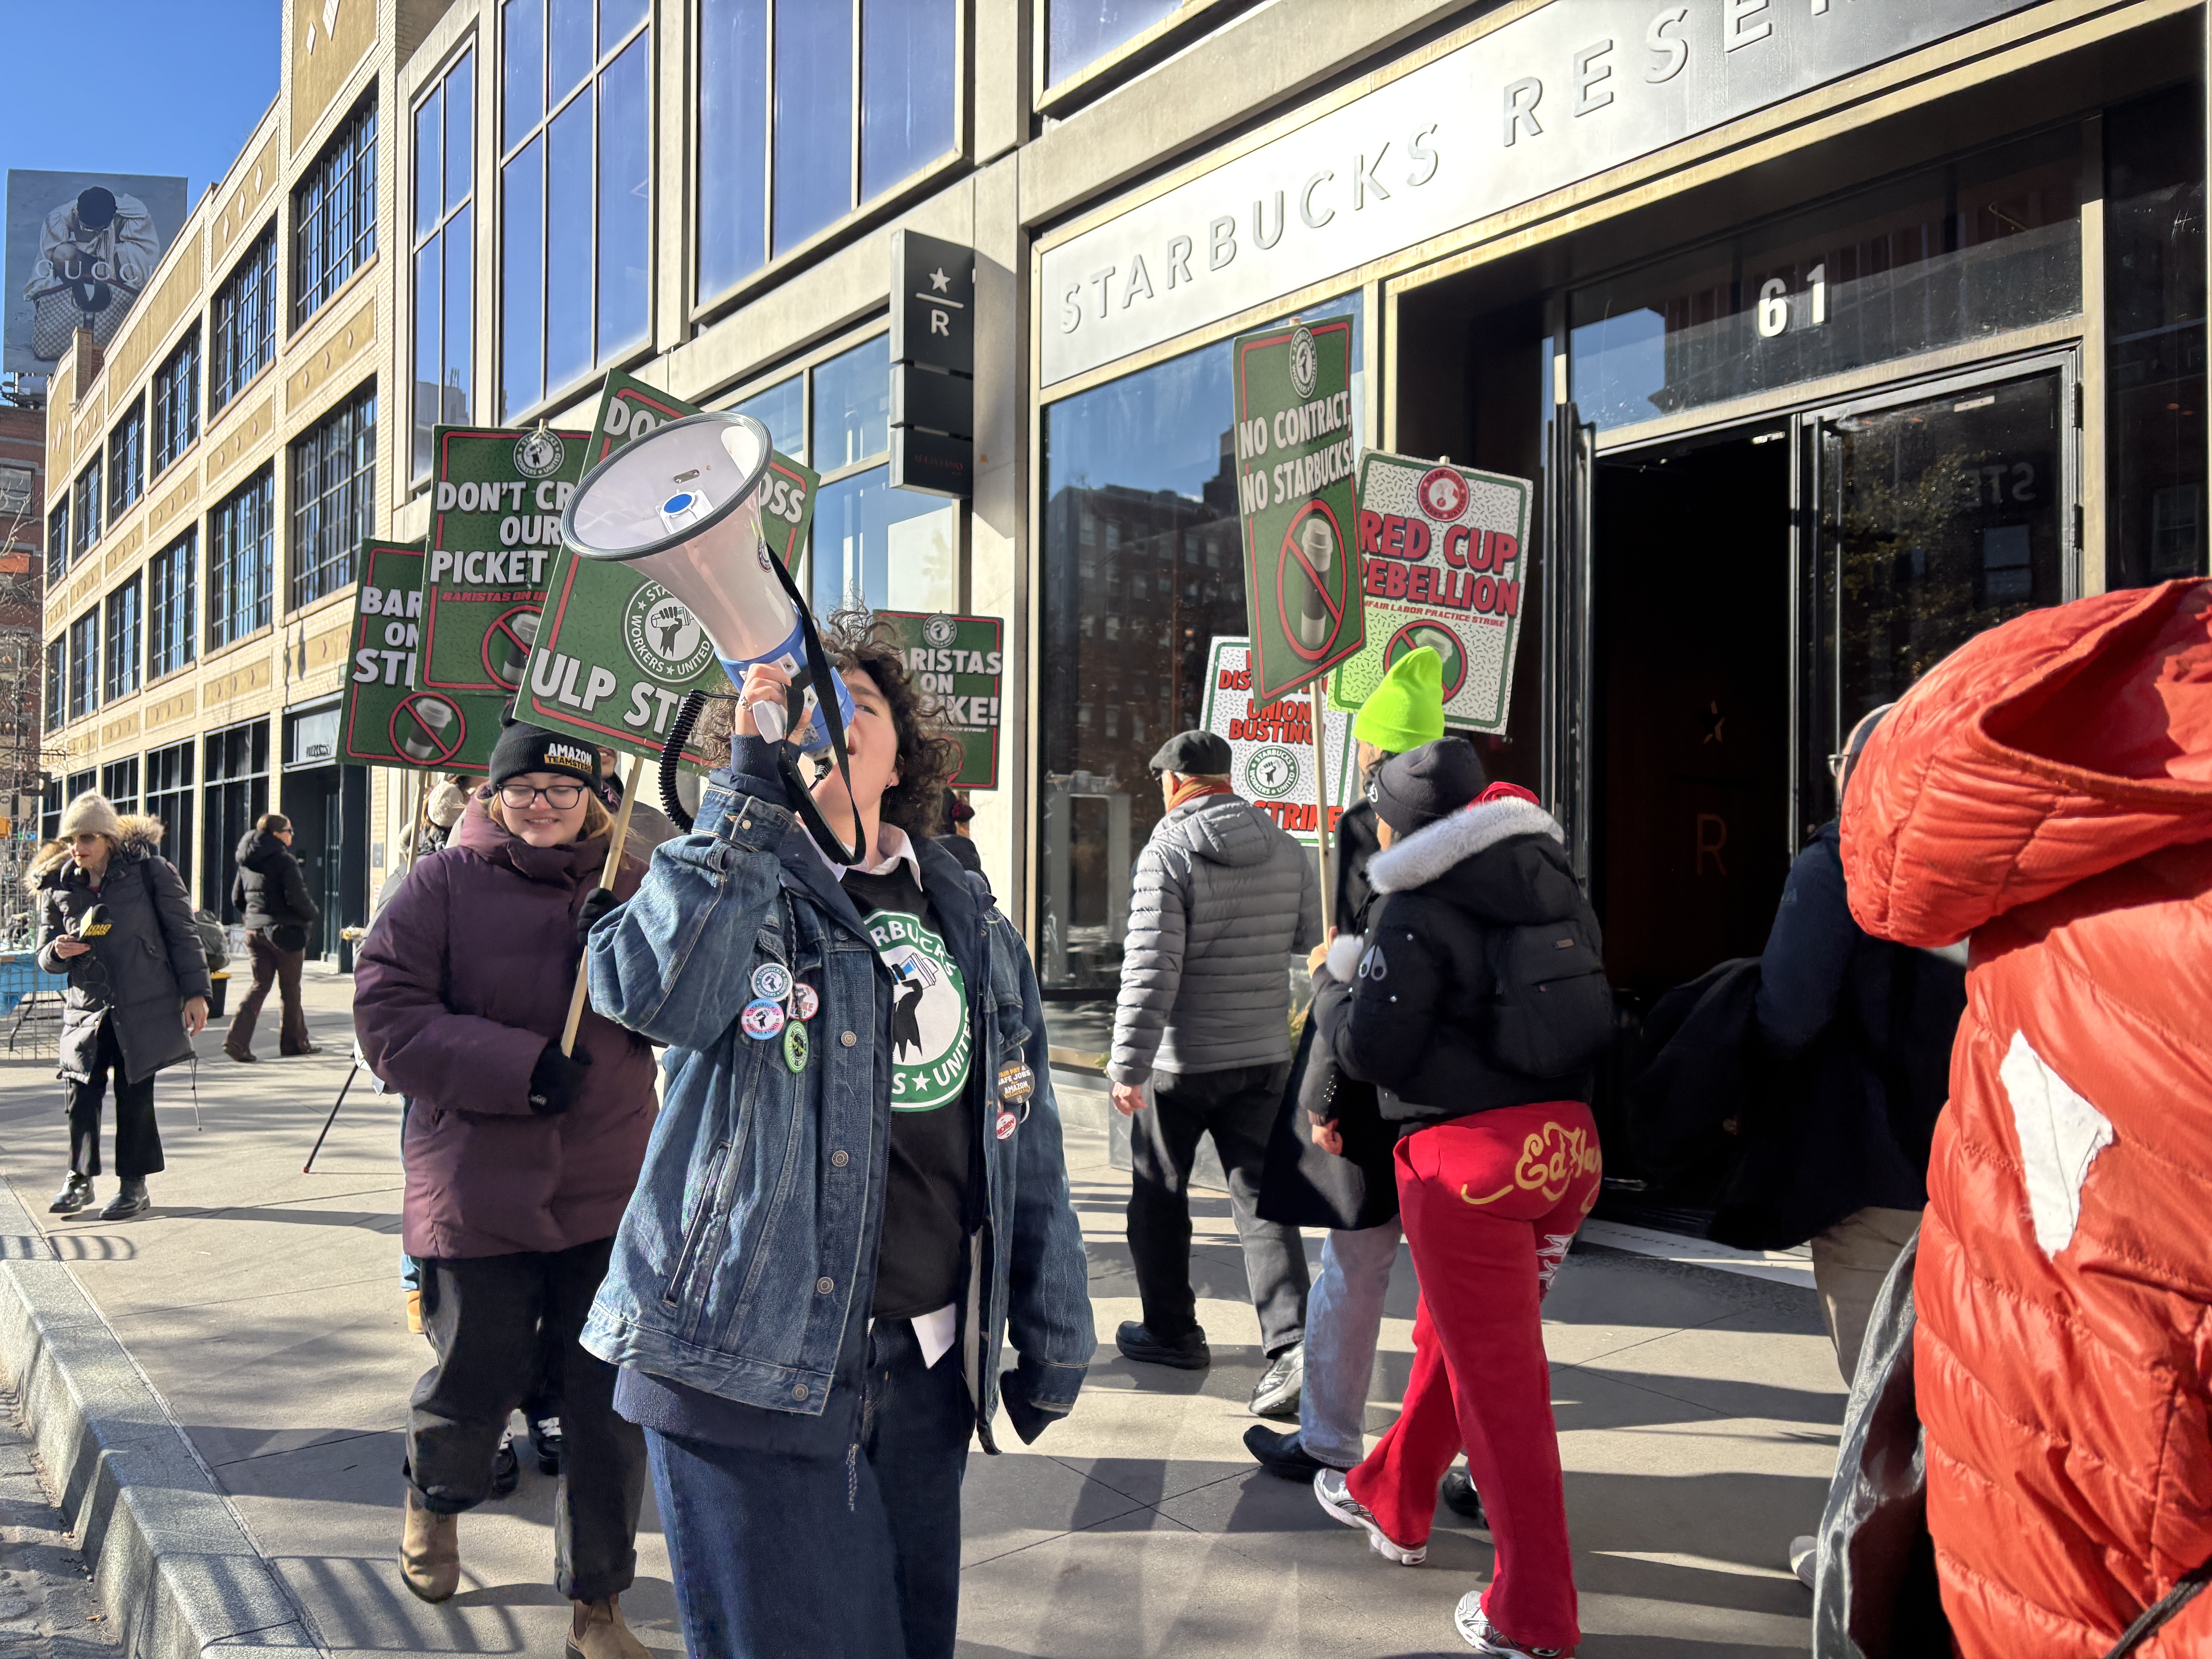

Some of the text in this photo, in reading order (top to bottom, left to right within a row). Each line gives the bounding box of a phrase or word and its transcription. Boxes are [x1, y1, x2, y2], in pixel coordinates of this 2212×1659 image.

[1060, 0, 1829, 334] STARBUCKS RESE
[1758, 263, 1826, 338] 61
[931, 309, 950, 337] R
[603, 396, 670, 441] DO
[1240, 391, 1351, 460] NO CONTRACT,
[1242, 437, 1354, 514] NO STARBUCKS!
[436, 481, 526, 512] DON'T
[500, 515, 562, 546] OUR
[1360, 509, 1519, 573] RED CUP
[430, 550, 548, 583] PICKET
[442, 591, 511, 602] BARISTAS
[512, 591, 531, 601] ON
[1362, 558, 1520, 616] EBELLION
[1391, 604, 1423, 616] LABOR
[1424, 608, 1470, 622] PRACTICE
[1472, 616, 1506, 627] STRIKE
[630, 614, 710, 675] WORKERS UNITED
[530, 647, 687, 735] ULP ST
[920, 673, 954, 694] ON
[548, 743, 592, 766] AMAZON
[1254, 749, 1293, 765] STARBUCKS
[1249, 769, 1295, 794] WORKERS UNITED
[1697, 812, 1728, 876] R
[757, 967, 783, 979] STARBUCKS
[757, 978, 788, 997] WORKERS UNITED
[750, 1002, 778, 1013] STARBUCKS
[746, 1018, 780, 1035] WORKERS UNITED
[999, 1070, 1010, 1078] AIR
[1010, 1066, 1020, 1075] PAY
[1013, 1070, 1031, 1080] JOBS
[1005, 1080, 1029, 1095] AMAZON
